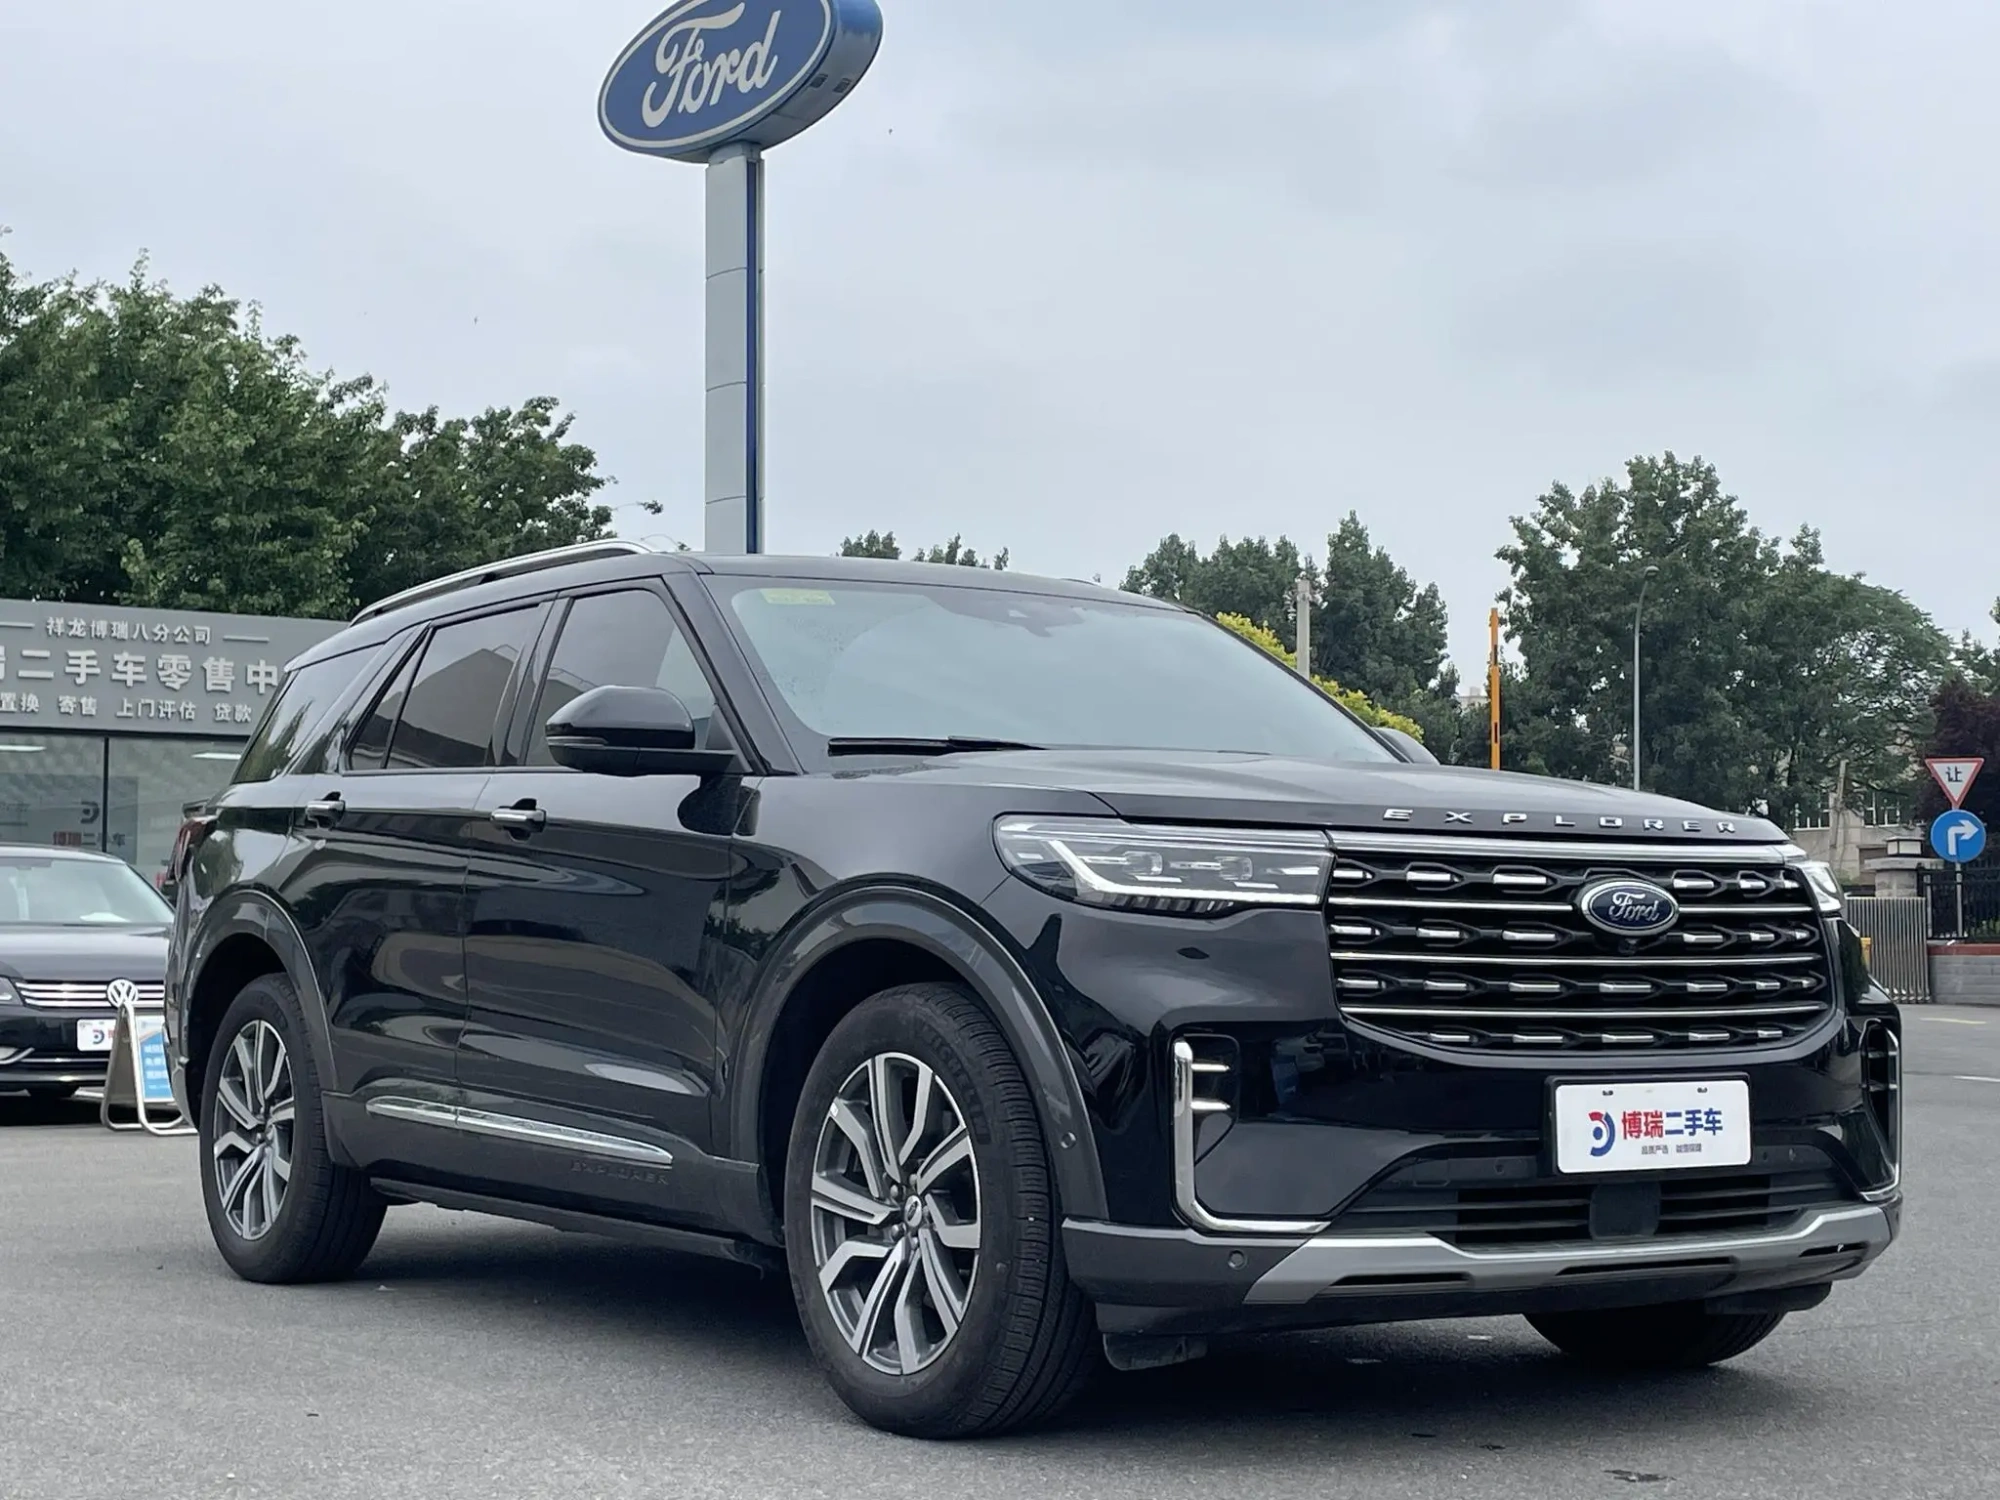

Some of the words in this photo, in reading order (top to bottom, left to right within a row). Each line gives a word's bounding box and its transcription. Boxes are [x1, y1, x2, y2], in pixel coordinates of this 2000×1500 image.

[641, 2, 781, 128] Ford
[46, 616, 212, 646] 祥龙博瑞八分公司
[0, 645, 279, 694] 二手车零售中
[58, 695, 98, 717] 寄售
[116, 698, 196, 720] 上门评估
[213, 702, 252, 723] 贷款
[1946, 766, 1963, 782] 让
[1382, 808, 1736, 834] EXPLORER
[1608, 891, 1660, 921] Ford
[1622, 1108, 1723, 1139] 博瑞二手车
